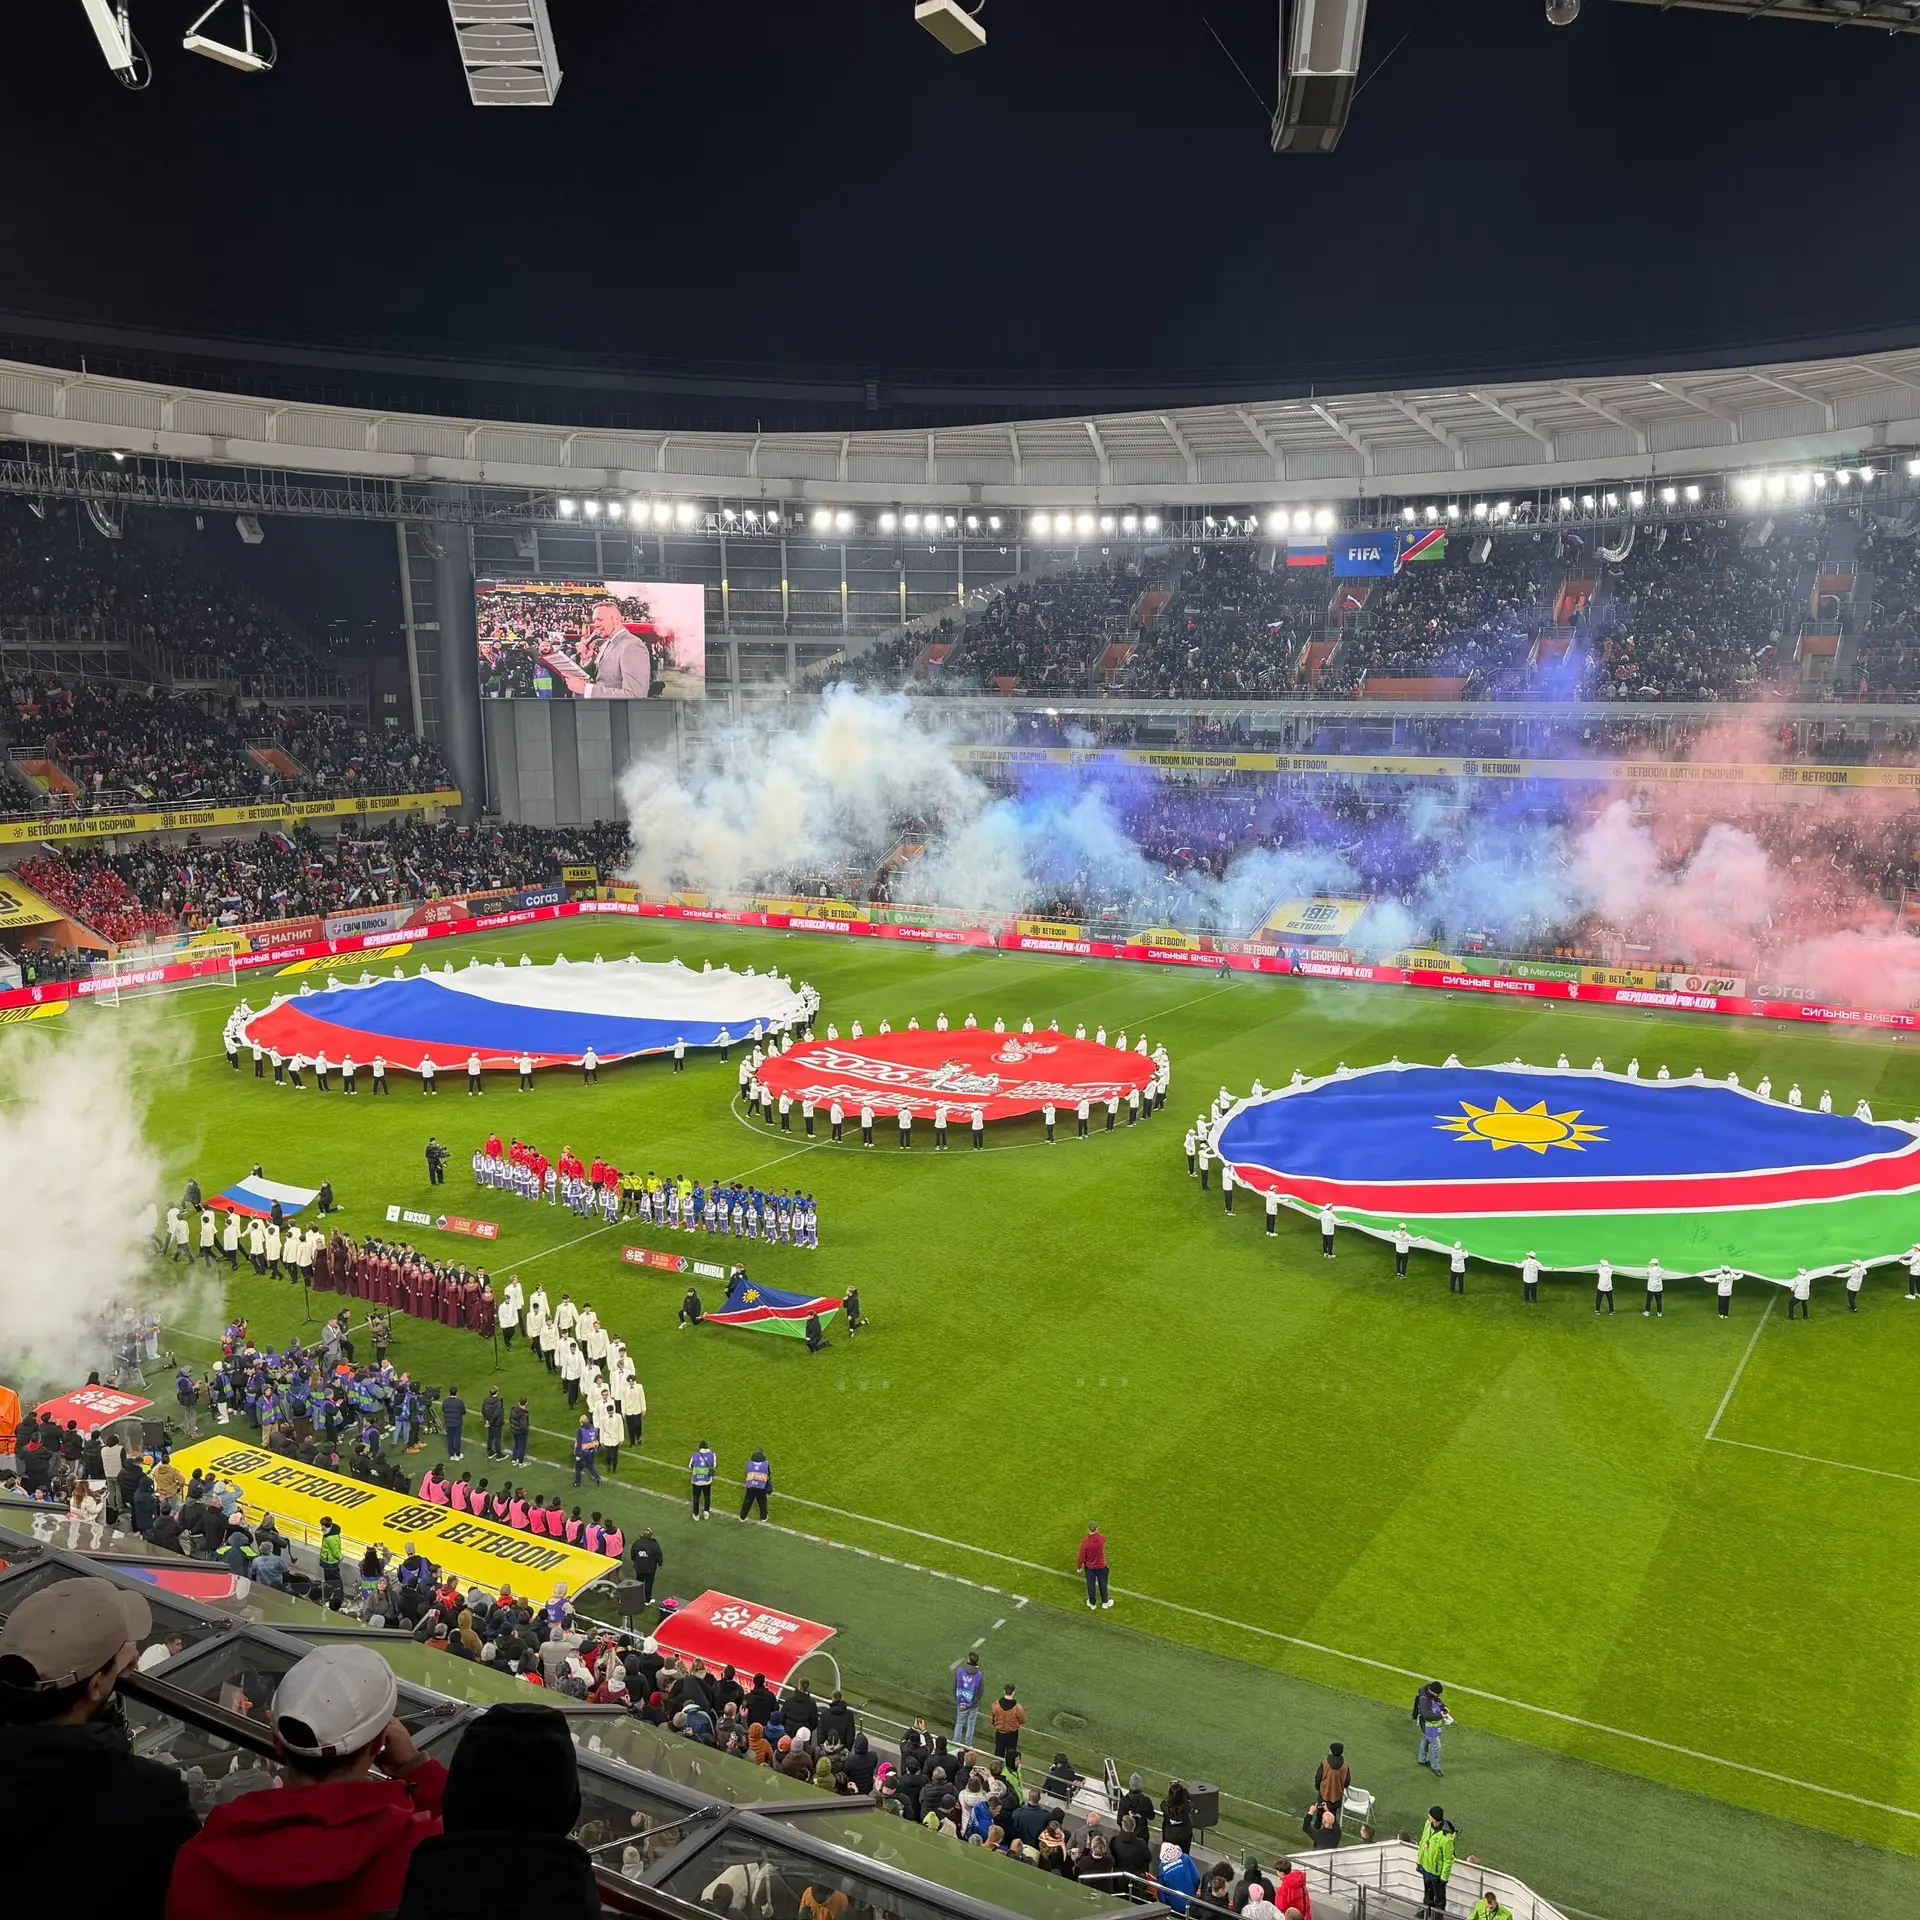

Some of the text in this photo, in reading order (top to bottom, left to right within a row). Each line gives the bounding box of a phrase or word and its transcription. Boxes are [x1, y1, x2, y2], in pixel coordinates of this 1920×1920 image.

[1348, 548, 1381, 561] FIFA
[1149, 755, 1236, 767] BETBOOM МАТЧИ СБОРНОЙ
[1293, 759, 1328, 769] BETBOOM
[1482, 763, 1521, 774] BETBOOM
[1627, 766, 1744, 780] BETBOOM МАТЧИ СБОРНОЙ
[1802, 771, 1847, 783] BETBOOM
[248, 801, 336, 819] BETBOOM МАТЧИ СБОРНОЙ
[370, 797, 400, 809] BETBOOM
[179, 813, 215, 825] BETBOOM
[27, 816, 136, 837] BETBOOM МАТЧИ СБОРНОЙ
[525, 892, 559, 907] согаз
[831, 909, 858, 919] BETBOOM
[361, 917, 388, 930] ПЛЮСЫ
[1286, 920, 1336, 931] BETBOOM
[271, 928, 313, 944] МАГНИТ
[899, 928, 965, 941] СИЛЬНЫЕ ВМЕСТЕ
[1042, 927, 1067, 936] BETBOOM
[1155, 936, 1186, 947] BETBOOM
[228, 947, 305, 967] СИЛЬНЫЕ ВМЕСТЕ
[307, 947, 392, 971] BETBOOM
[1147, 950, 1225, 964] СИЛЬНЫЕ ВМЕСТЕ
[1243, 943, 1280, 957] BETBOOM
[1311, 949, 1349, 963] СБОРНОЙ
[1414, 957, 1451, 970] BETBOOM
[1442, 975, 1536, 992] СИЛЬНЫЕ ВМЕСТЕ
[1801, 1006, 1915, 1025] СИЛЬНЫЕ ВМЕСТЕ
[402, 1210, 431, 1226] RUSSIA
[693, 1261, 725, 1279] NAMIBIA
[257, 1465, 378, 1510] BETBOOM
[436, 1522, 570, 1573] BETBOOM
[748, 1621, 782, 1636] МАТЧИ
[755, 1613, 800, 1633] BETBOOM
[739, 1627, 784, 1646] СБОРНОЙ
